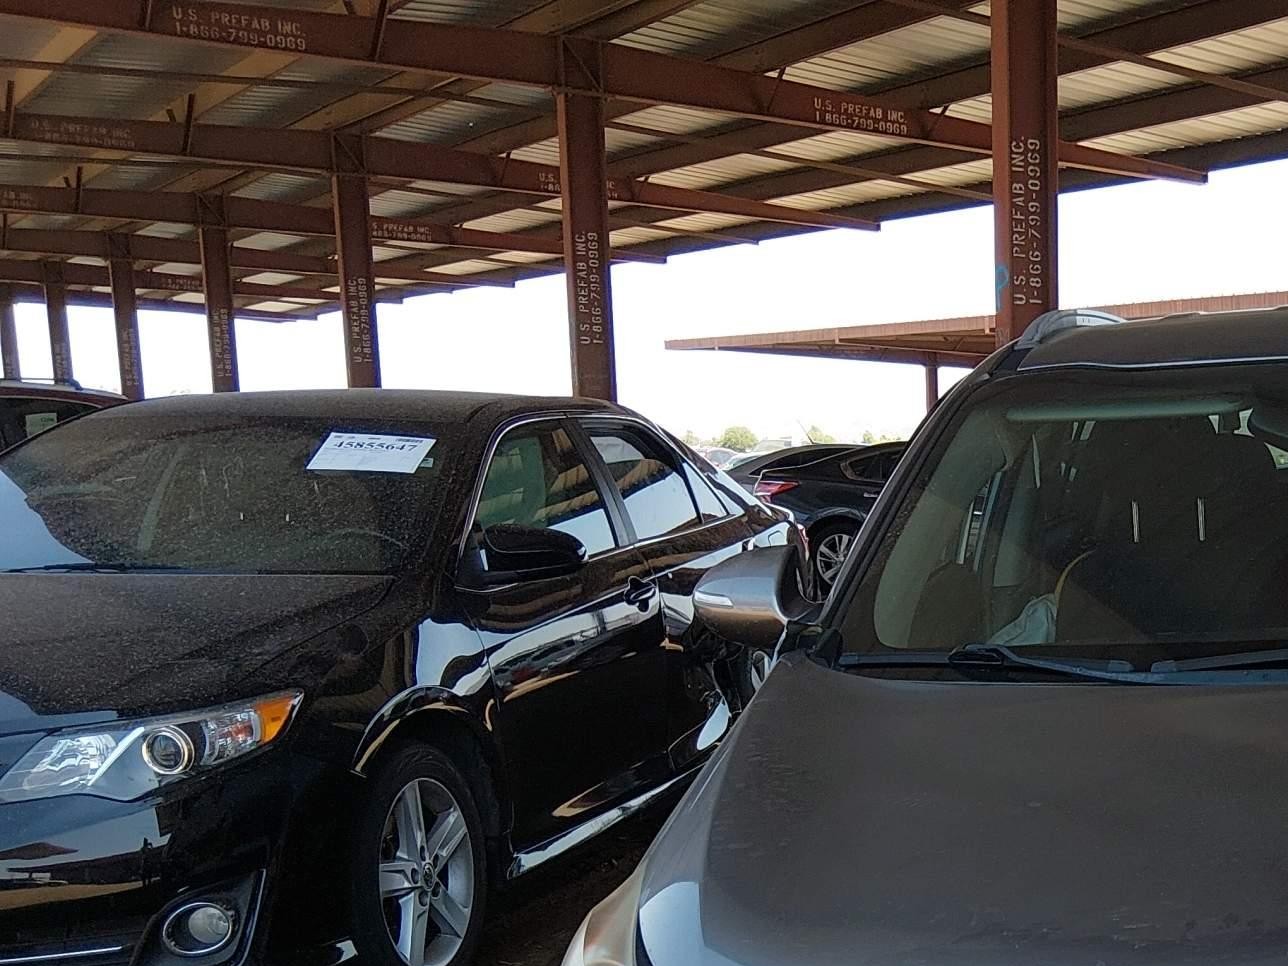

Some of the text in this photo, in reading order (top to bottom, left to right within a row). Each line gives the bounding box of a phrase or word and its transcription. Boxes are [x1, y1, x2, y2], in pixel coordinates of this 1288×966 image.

[172, 5, 306, 37] U.S. PREFAB INC.
[814, 97, 907, 123] U.S. PREFAB INC.
[1011, 135, 1027, 305] U.S. PREFAB INC.
[1027, 138, 1043, 305] 1-866-799-0969
[575, 231, 586, 255] INC.
[576, 262, 590, 313] PREFAB
